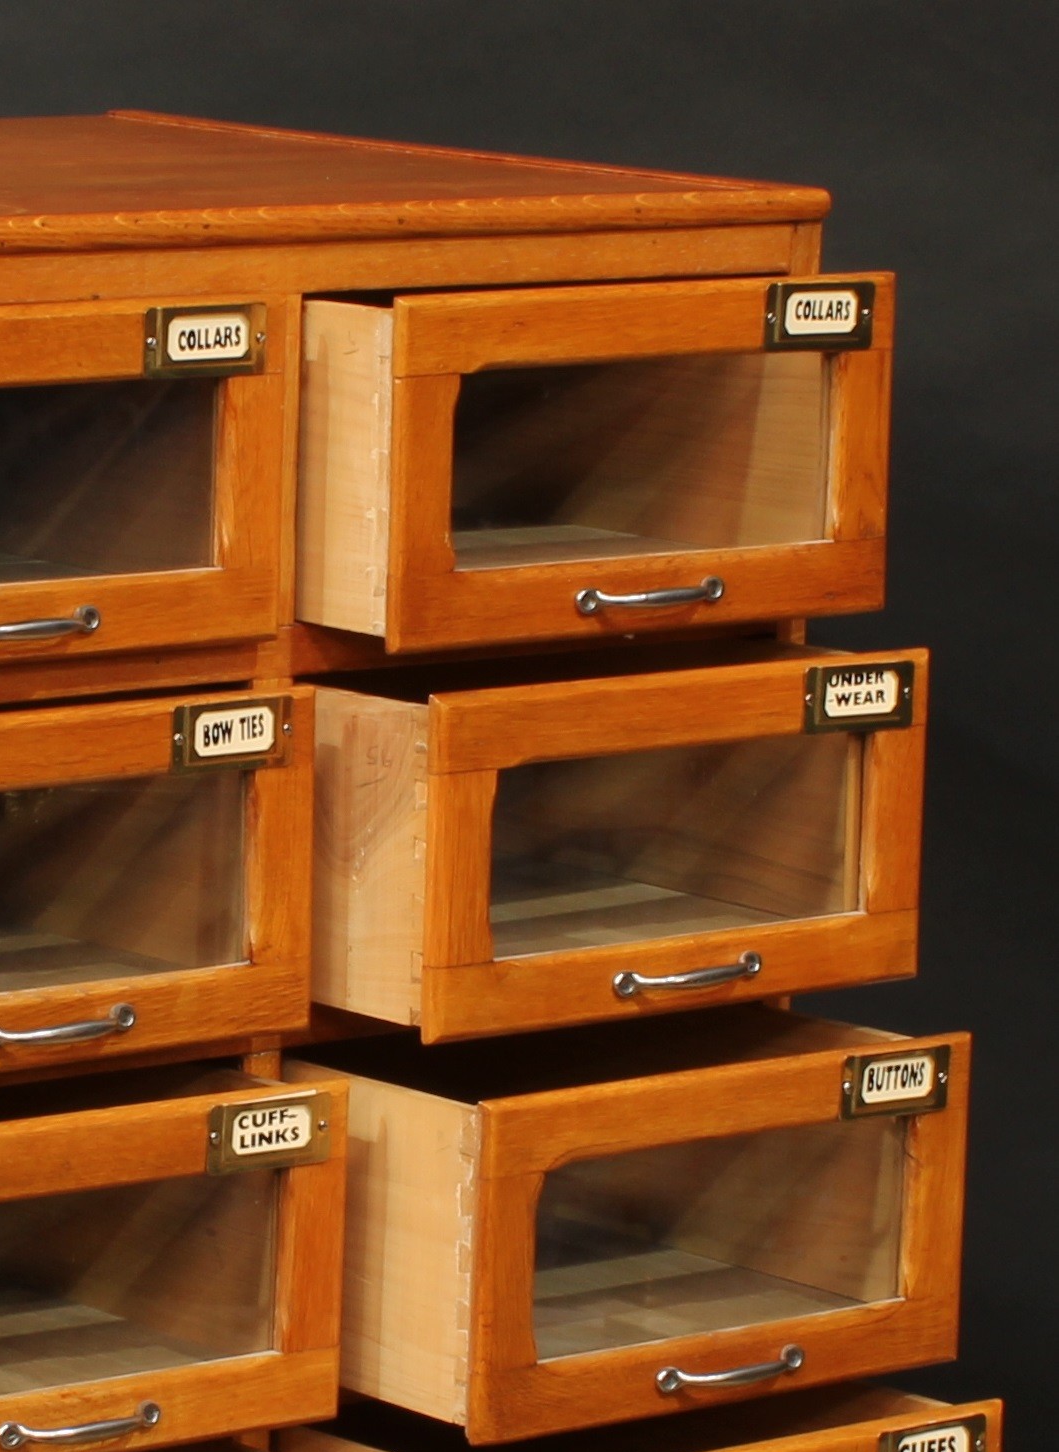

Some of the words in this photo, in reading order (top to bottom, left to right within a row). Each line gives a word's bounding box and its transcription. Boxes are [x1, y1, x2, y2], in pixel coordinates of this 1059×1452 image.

[795, 300, 851, 320] COLLARS
[178, 326, 241, 351] COLLARS
[829, 671, 884, 687] UNDER
[203, 719, 233, 747] BOW
[239, 713, 264, 740] TIES
[867, 1063, 925, 1092] BUTTONS
[240, 1127, 300, 1149] LINKS
